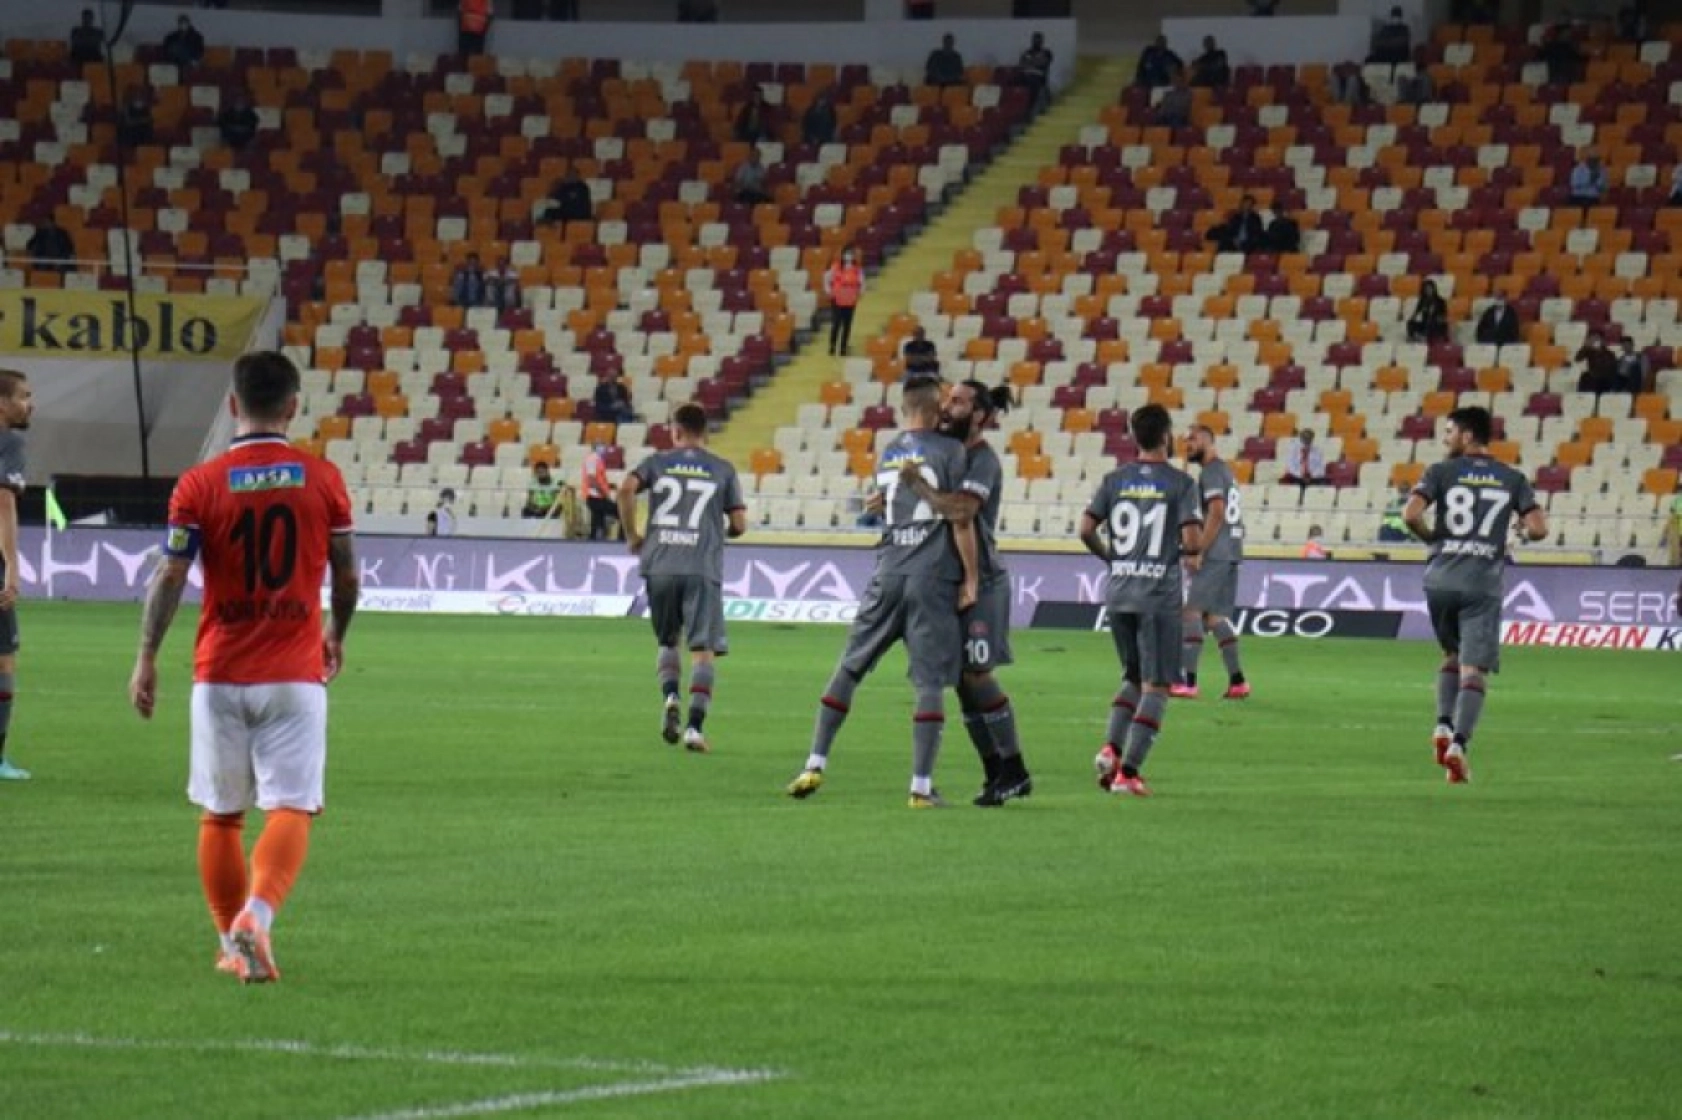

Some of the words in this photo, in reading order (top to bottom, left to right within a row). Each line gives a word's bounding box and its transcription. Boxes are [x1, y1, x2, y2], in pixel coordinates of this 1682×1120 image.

[20, 297, 217, 353] kablo
[651, 477, 718, 529] 27
[1110, 500, 1168, 558] 91
[1446, 487, 1511, 537] 87
[229, 503, 297, 592] 10
[966, 639, 990, 664] 10
[1504, 621, 1650, 648] MERCAN
